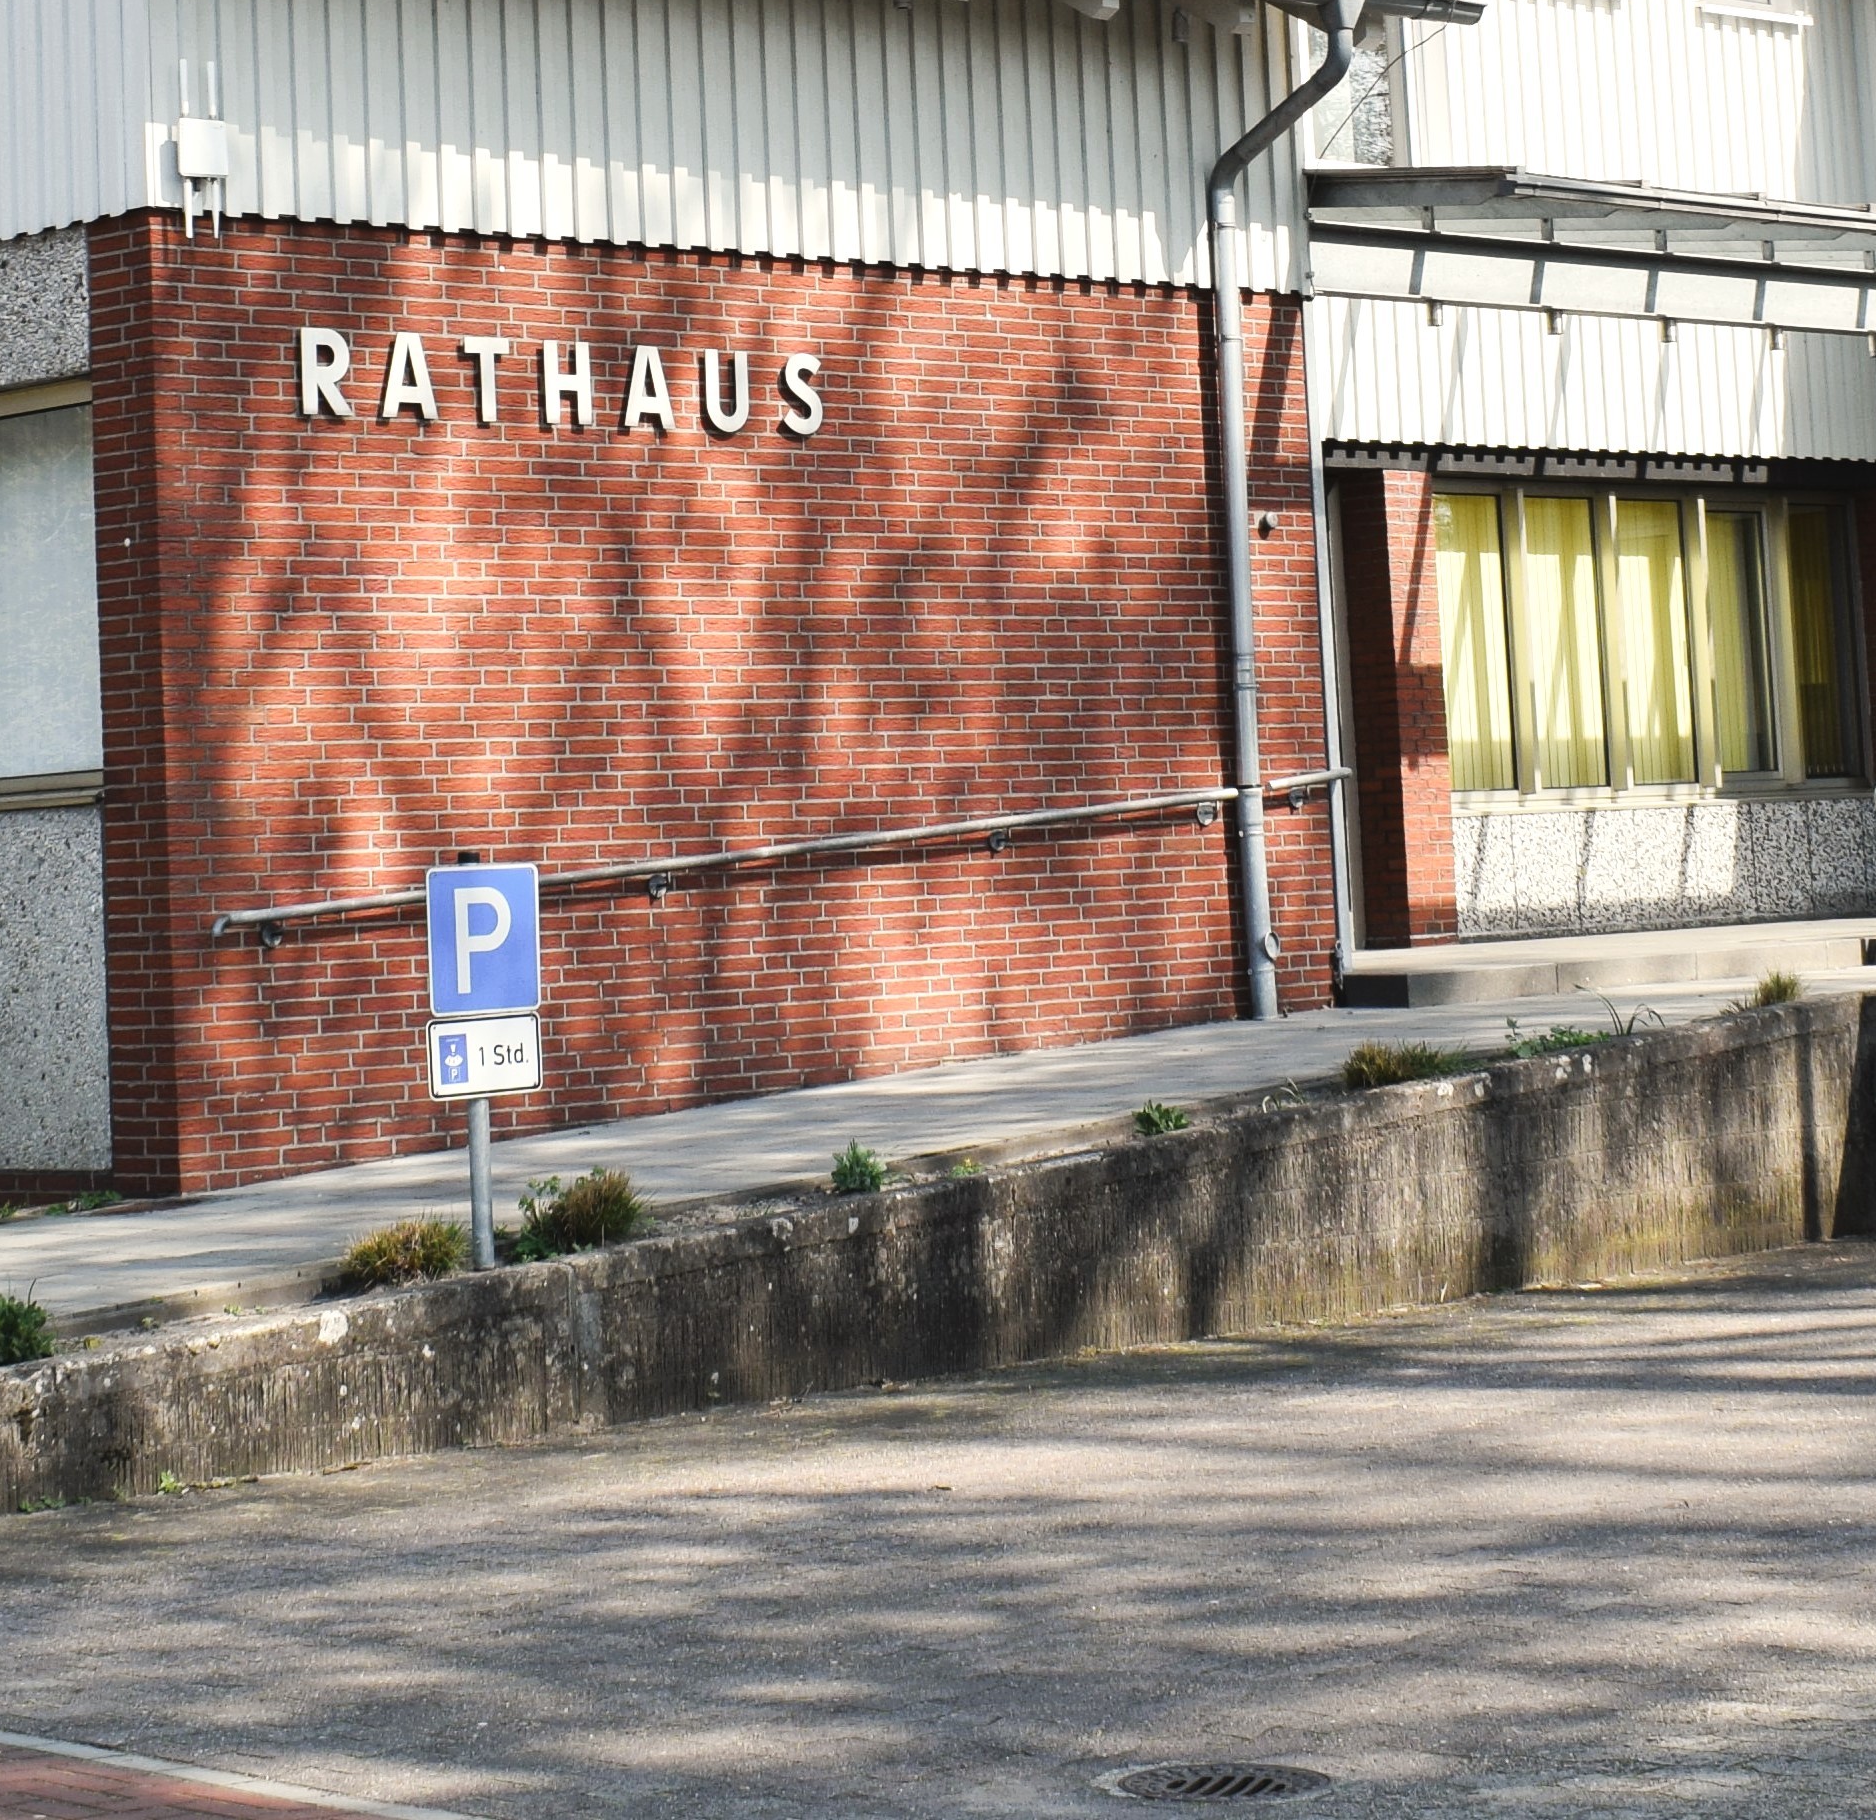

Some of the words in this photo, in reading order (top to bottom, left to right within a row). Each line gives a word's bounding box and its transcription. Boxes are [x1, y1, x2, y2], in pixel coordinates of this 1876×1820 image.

[300, 327, 822, 435] RATHAUS
[454, 886, 511, 994] P
[478, 1046, 484, 1066] 1
[493, 1042, 529, 1066] Std.
